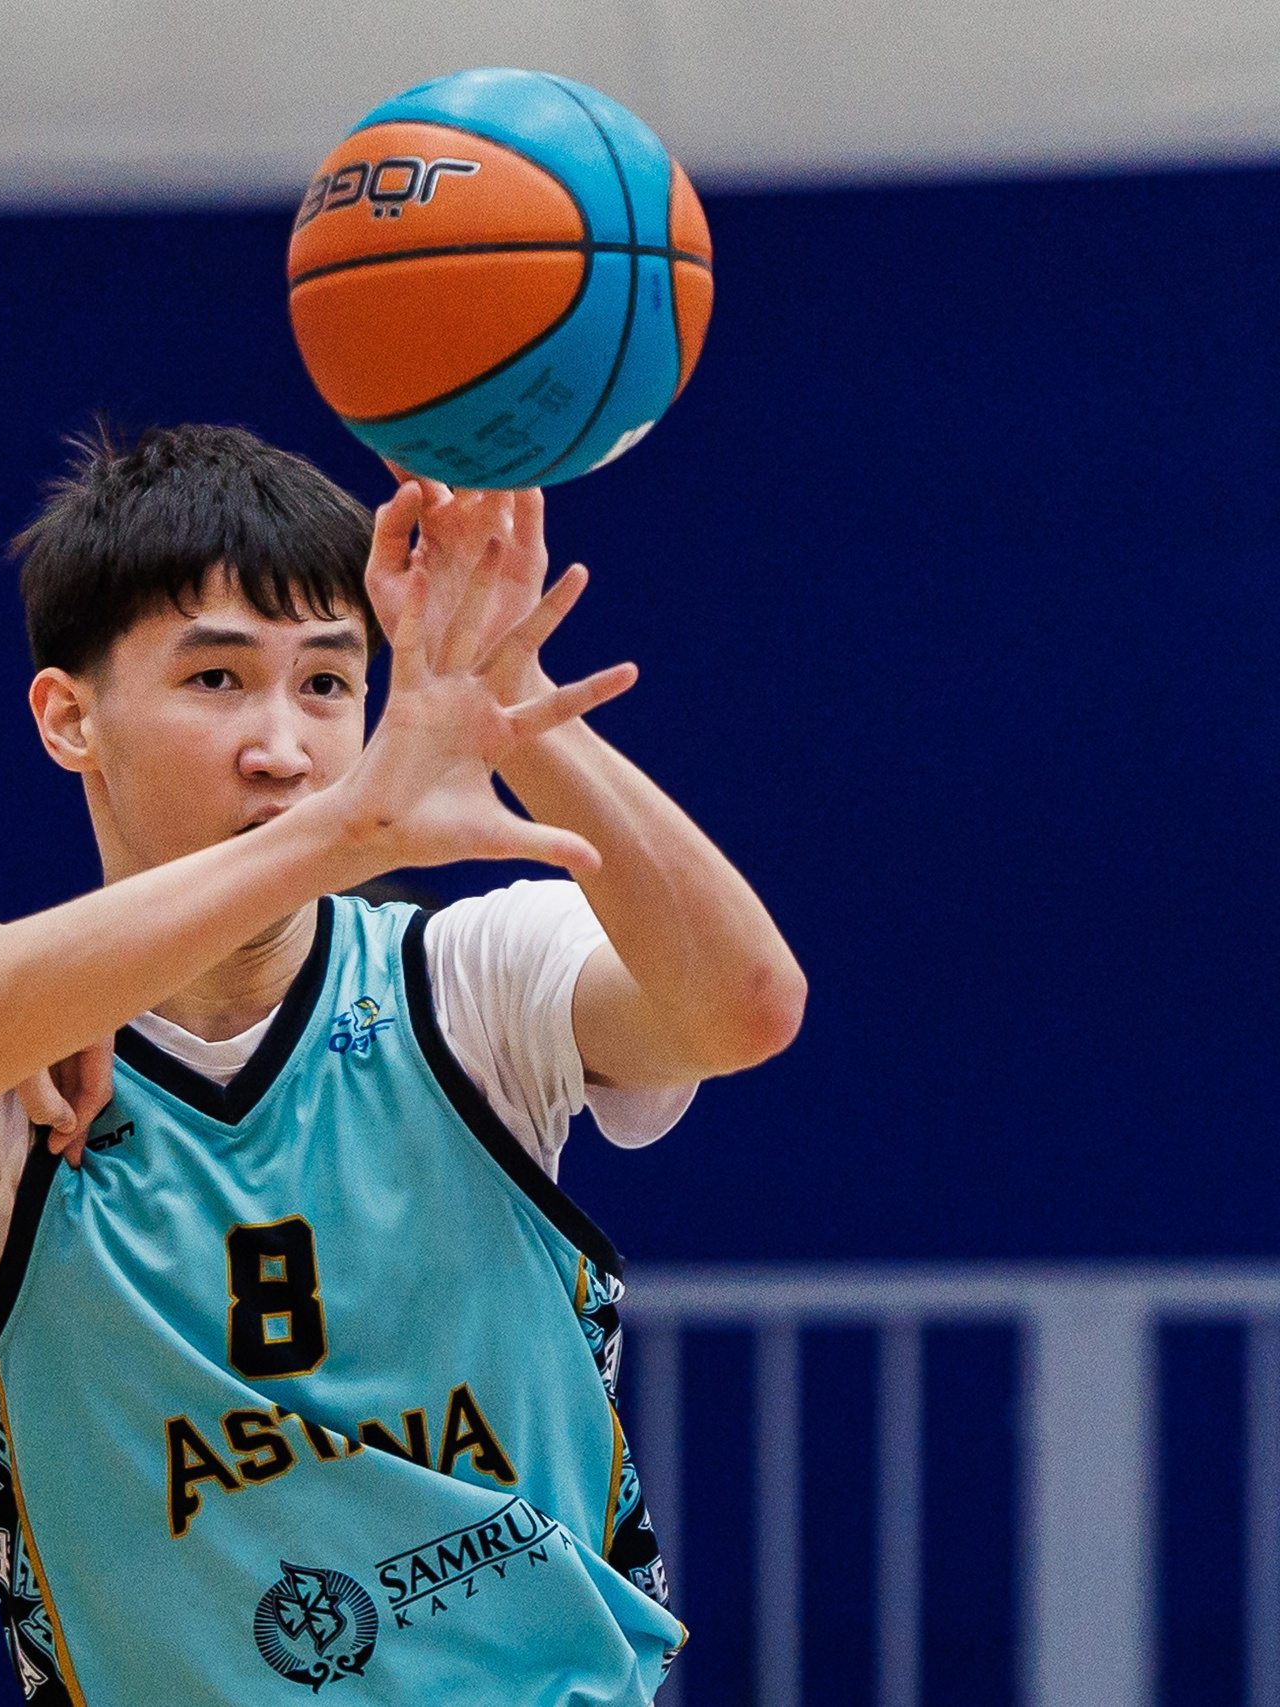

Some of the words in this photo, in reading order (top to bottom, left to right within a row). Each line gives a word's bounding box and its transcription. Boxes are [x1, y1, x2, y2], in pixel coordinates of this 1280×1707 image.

[295, 155, 482, 236] JÖGE
[224, 1215, 328, 1381] 8
[164, 1381, 519, 1539] ASTNA
[394, 1530, 573, 1630] KAZYNA
